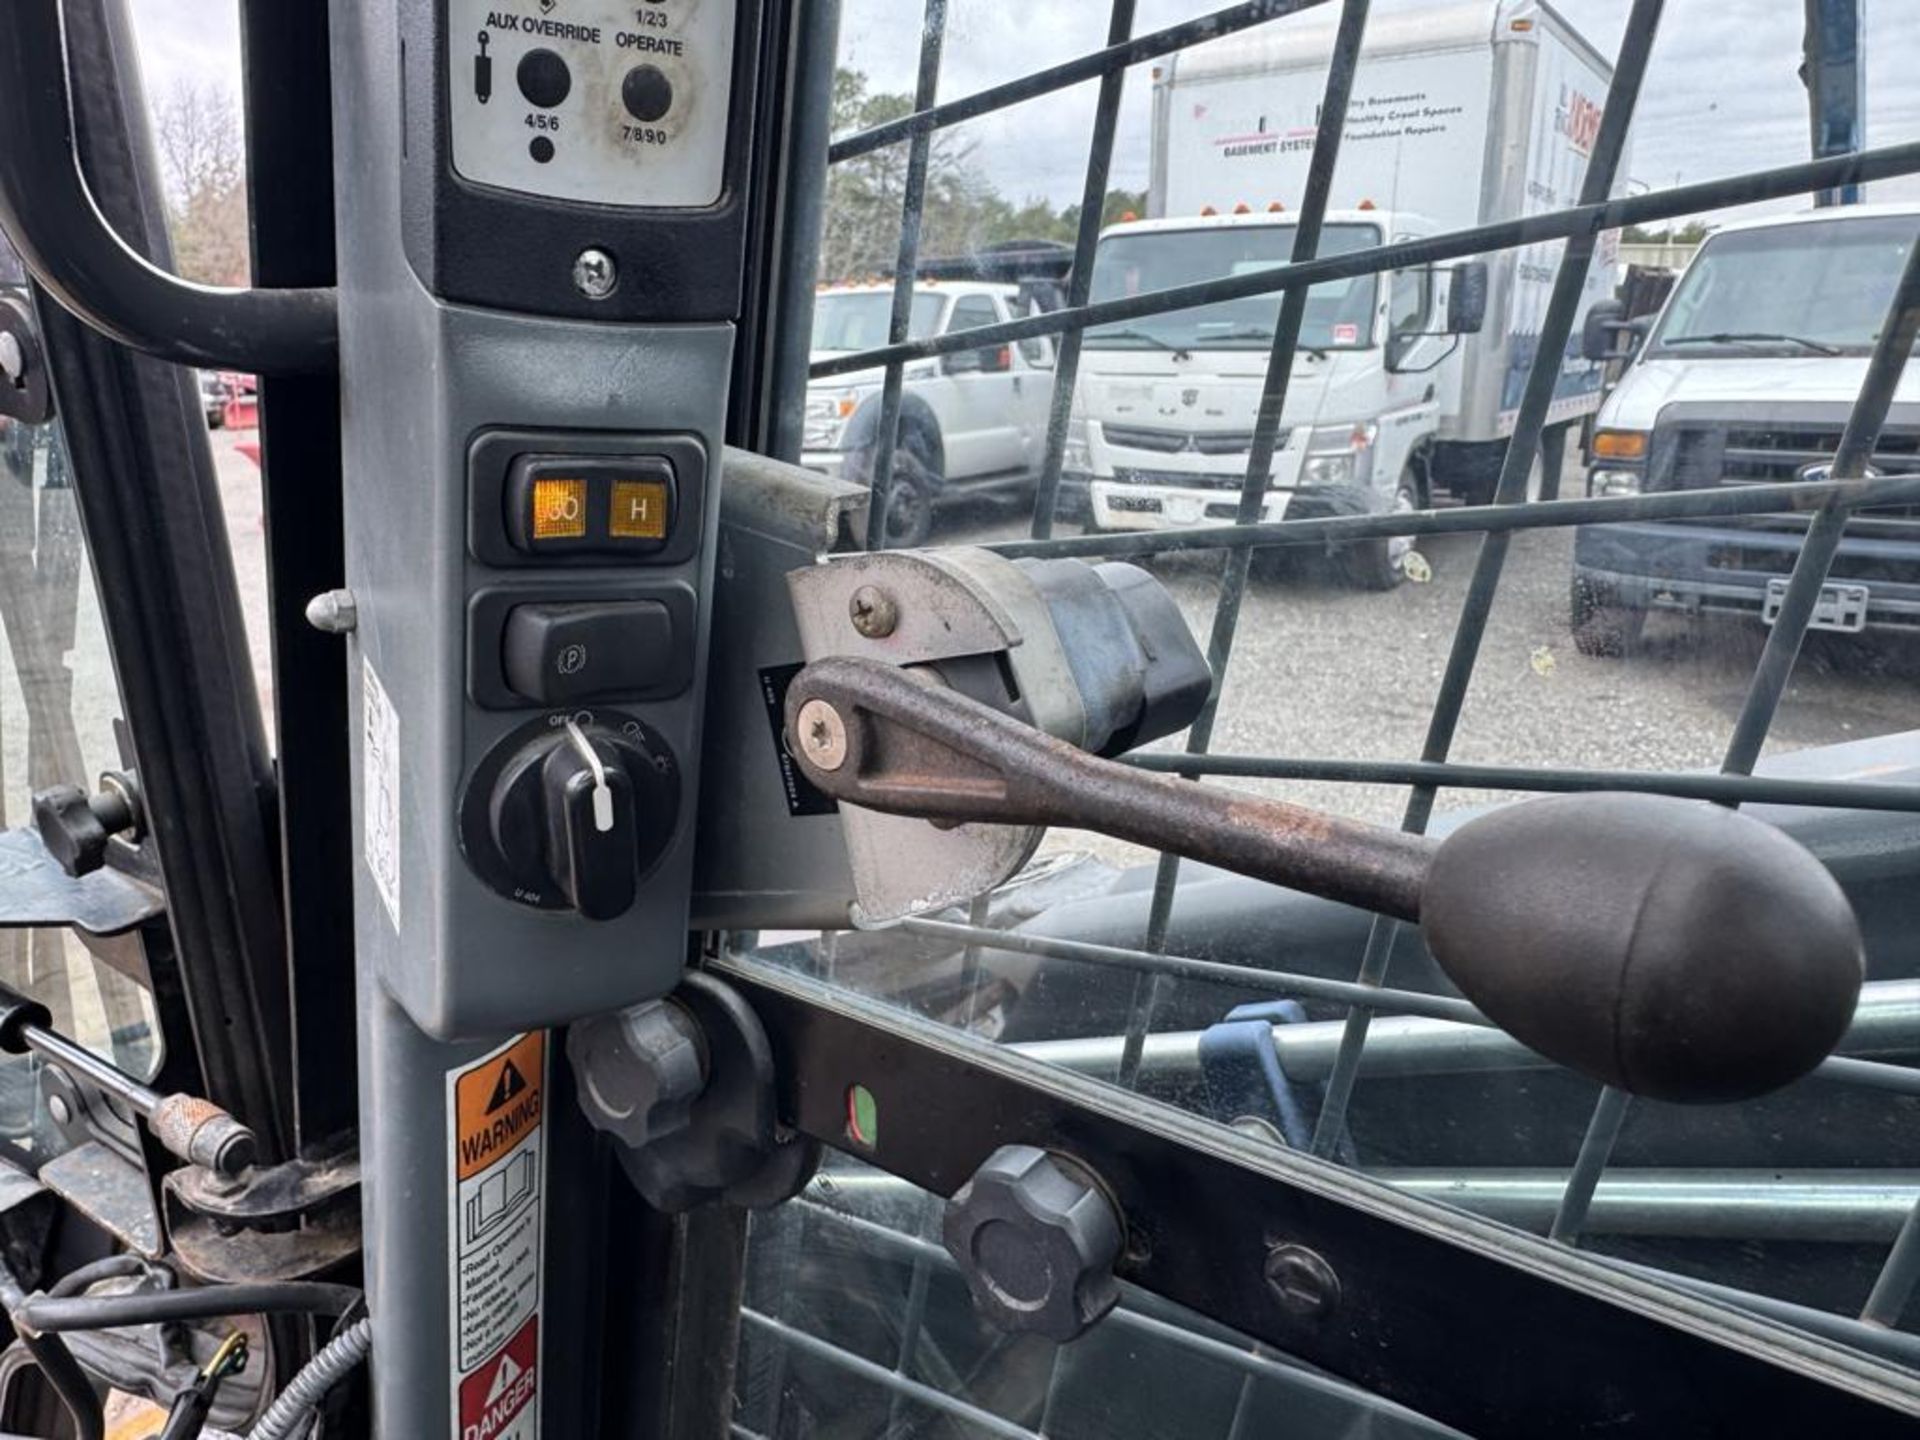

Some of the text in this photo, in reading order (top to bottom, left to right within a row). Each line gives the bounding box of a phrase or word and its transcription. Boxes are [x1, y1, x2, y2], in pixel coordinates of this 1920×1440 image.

[486, 11, 600, 45] AUX OVERRIDE
[635, 10, 668, 28] 1/2/3
[615, 31, 683, 57] OPERATE
[524, 113, 560, 132] 4/5/6
[621, 125, 667, 145] 7/8/9/0
[631, 499, 647, 522] H
[462, 1090, 540, 1167] WARNING
[464, 1367, 534, 1440] DANGER
